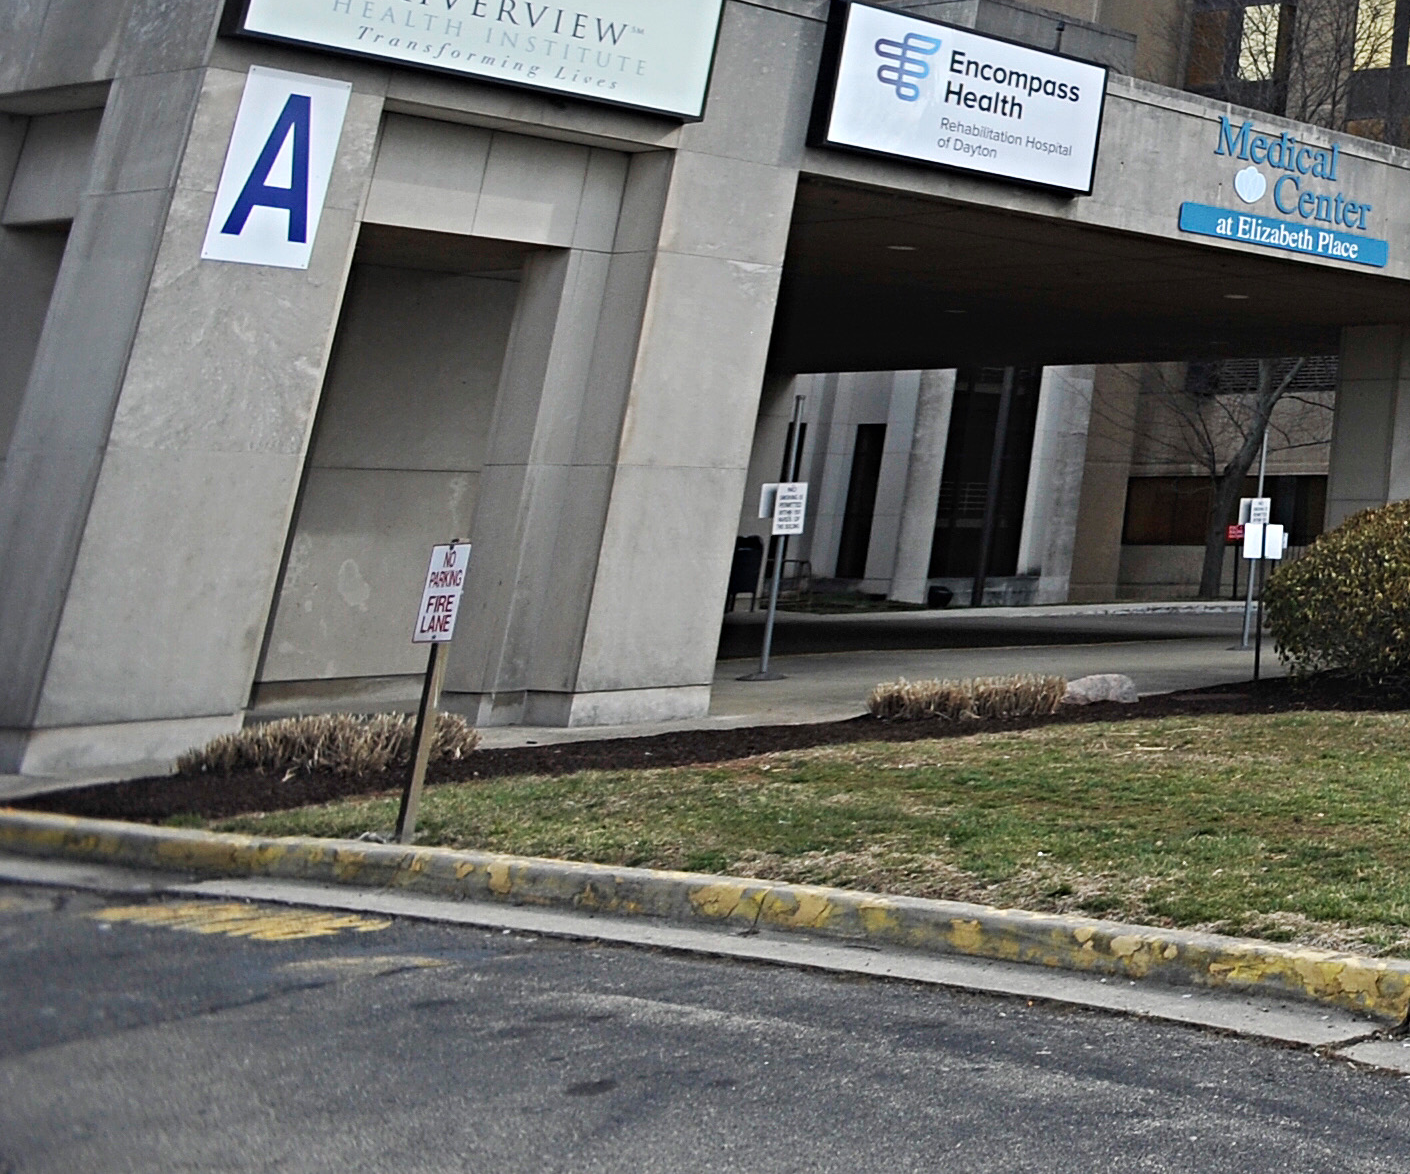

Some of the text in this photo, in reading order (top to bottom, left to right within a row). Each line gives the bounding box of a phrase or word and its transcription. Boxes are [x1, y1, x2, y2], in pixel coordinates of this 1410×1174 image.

[356, 25, 618, 90] Transforming Lives
[485, 27, 647, 76] INSTITUTE
[949, 49, 1080, 102] Encompass
[944, 80, 1023, 119] Health
[937, 136, 997, 159] of Dayton
[940, 117, 1073, 157] Rehabilitation Hospital
[1213, 115, 1341, 181] Medical
[220, 93, 311, 243] A
[1273, 173, 1373, 231] Center
[1216, 215, 1359, 259] at Elizabeth Place
[428, 569, 463, 588] PARKING
[442, 550, 457, 568] NO
[420, 614, 451, 634] LANE
[426, 594, 455, 614] FIRE
